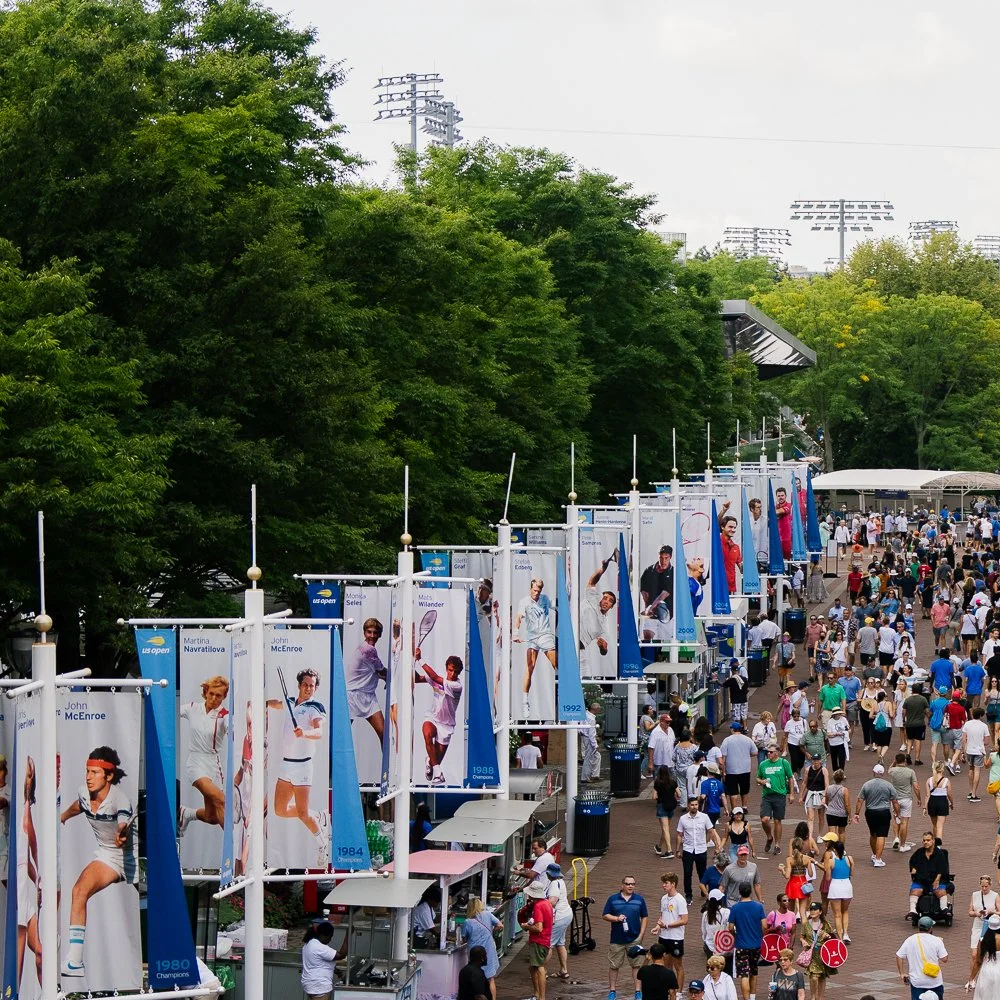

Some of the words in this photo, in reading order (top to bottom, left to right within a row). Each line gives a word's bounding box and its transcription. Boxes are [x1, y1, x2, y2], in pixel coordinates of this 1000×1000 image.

[64, 702, 88, 710] John
[64, 712, 106, 720] McEnroe
[338, 847, 363, 857] 1984
[156, 959, 190, 971] 1980
